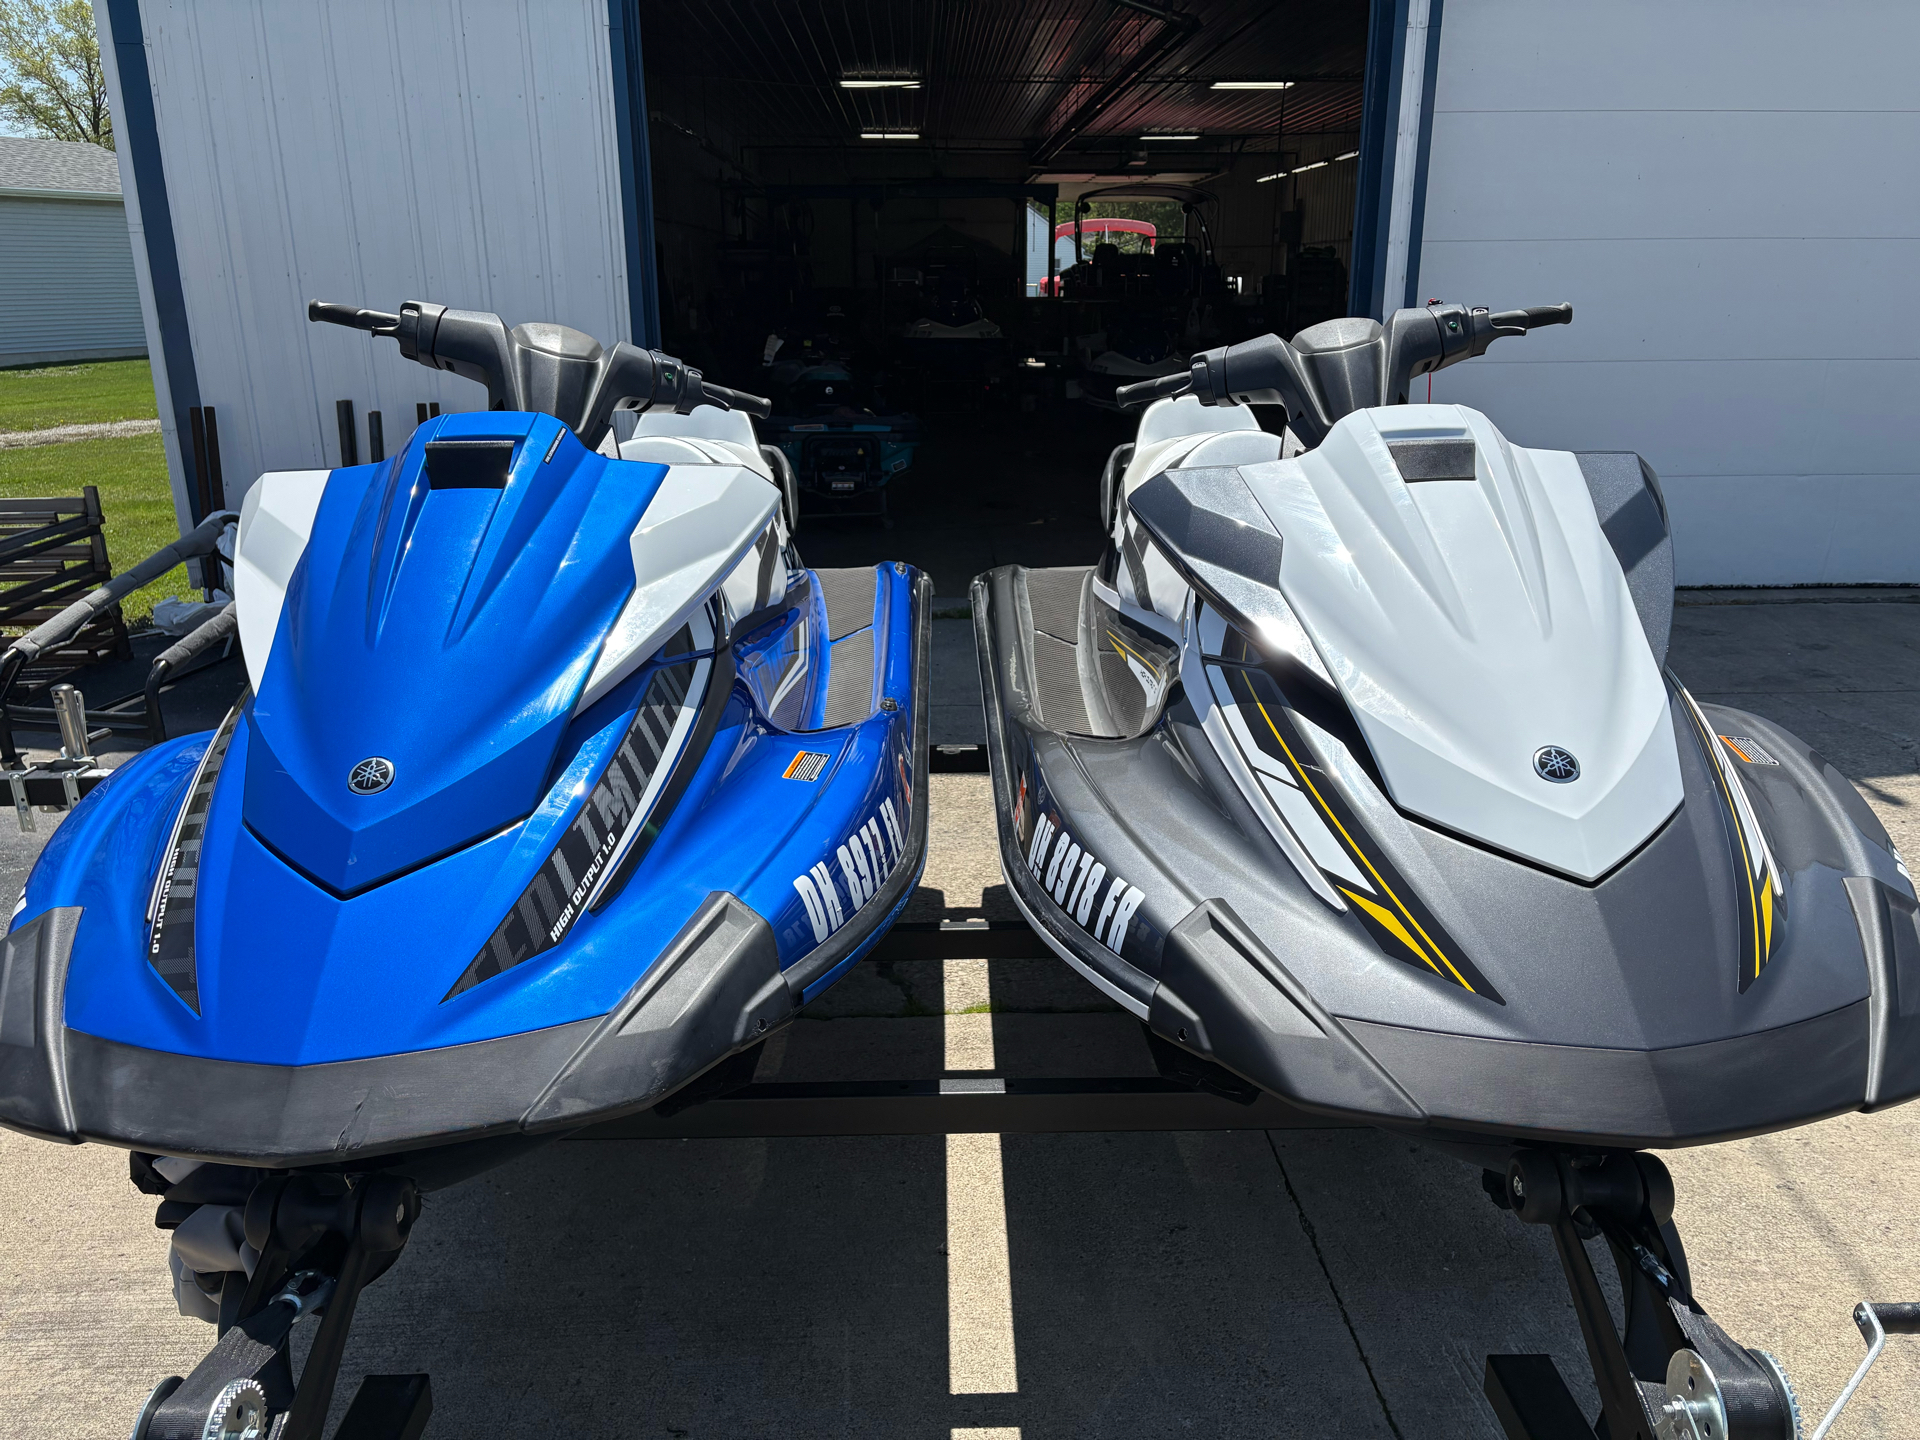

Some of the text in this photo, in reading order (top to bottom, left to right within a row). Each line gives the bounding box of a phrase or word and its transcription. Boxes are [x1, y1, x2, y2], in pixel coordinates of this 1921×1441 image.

[152, 848, 180, 954] HIGH OUTPUT 1.0
[549, 832, 616, 942] HIGH OUTPUT 1.0
[1027, 812, 1146, 956] OH 8978 FR
